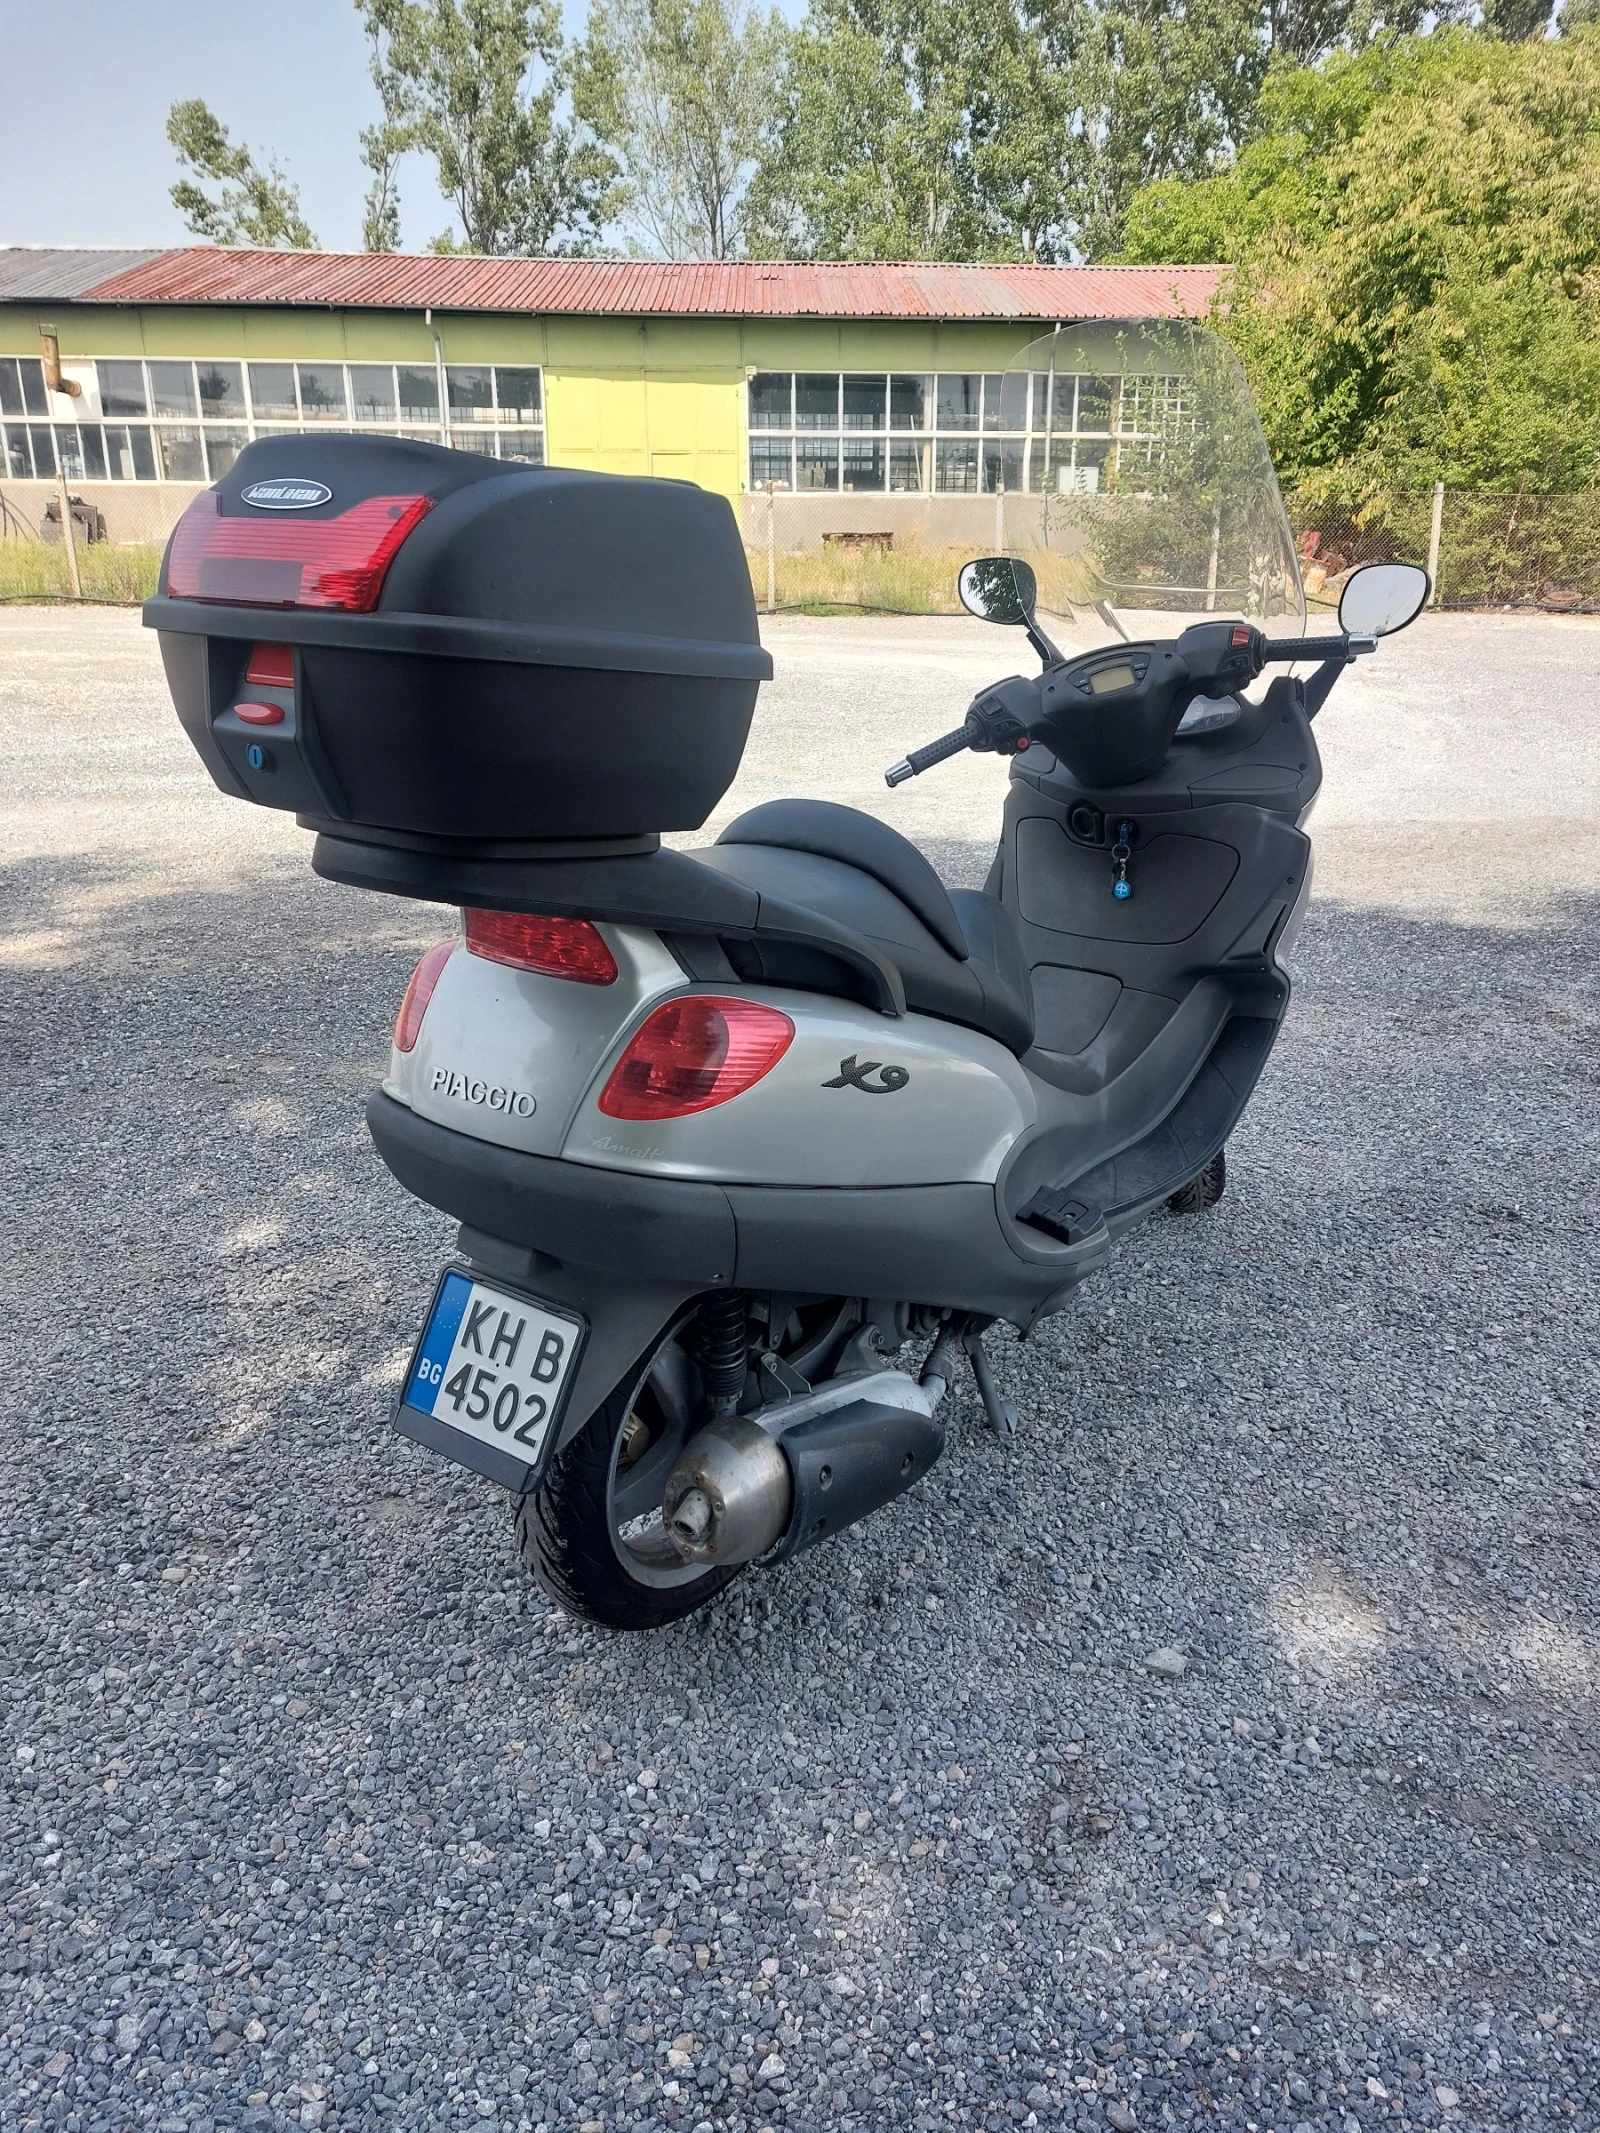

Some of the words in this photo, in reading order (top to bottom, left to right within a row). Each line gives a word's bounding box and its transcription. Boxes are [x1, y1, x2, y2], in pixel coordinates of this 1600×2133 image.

[430, 1065, 537, 1118] PIAGGIO
[820, 1053, 910, 1094] X9
[460, 1299, 528, 1368] KH
[530, 1328, 564, 1384] B
[417, 1357, 443, 1385] BG
[444, 1362, 547, 1448] 4502
